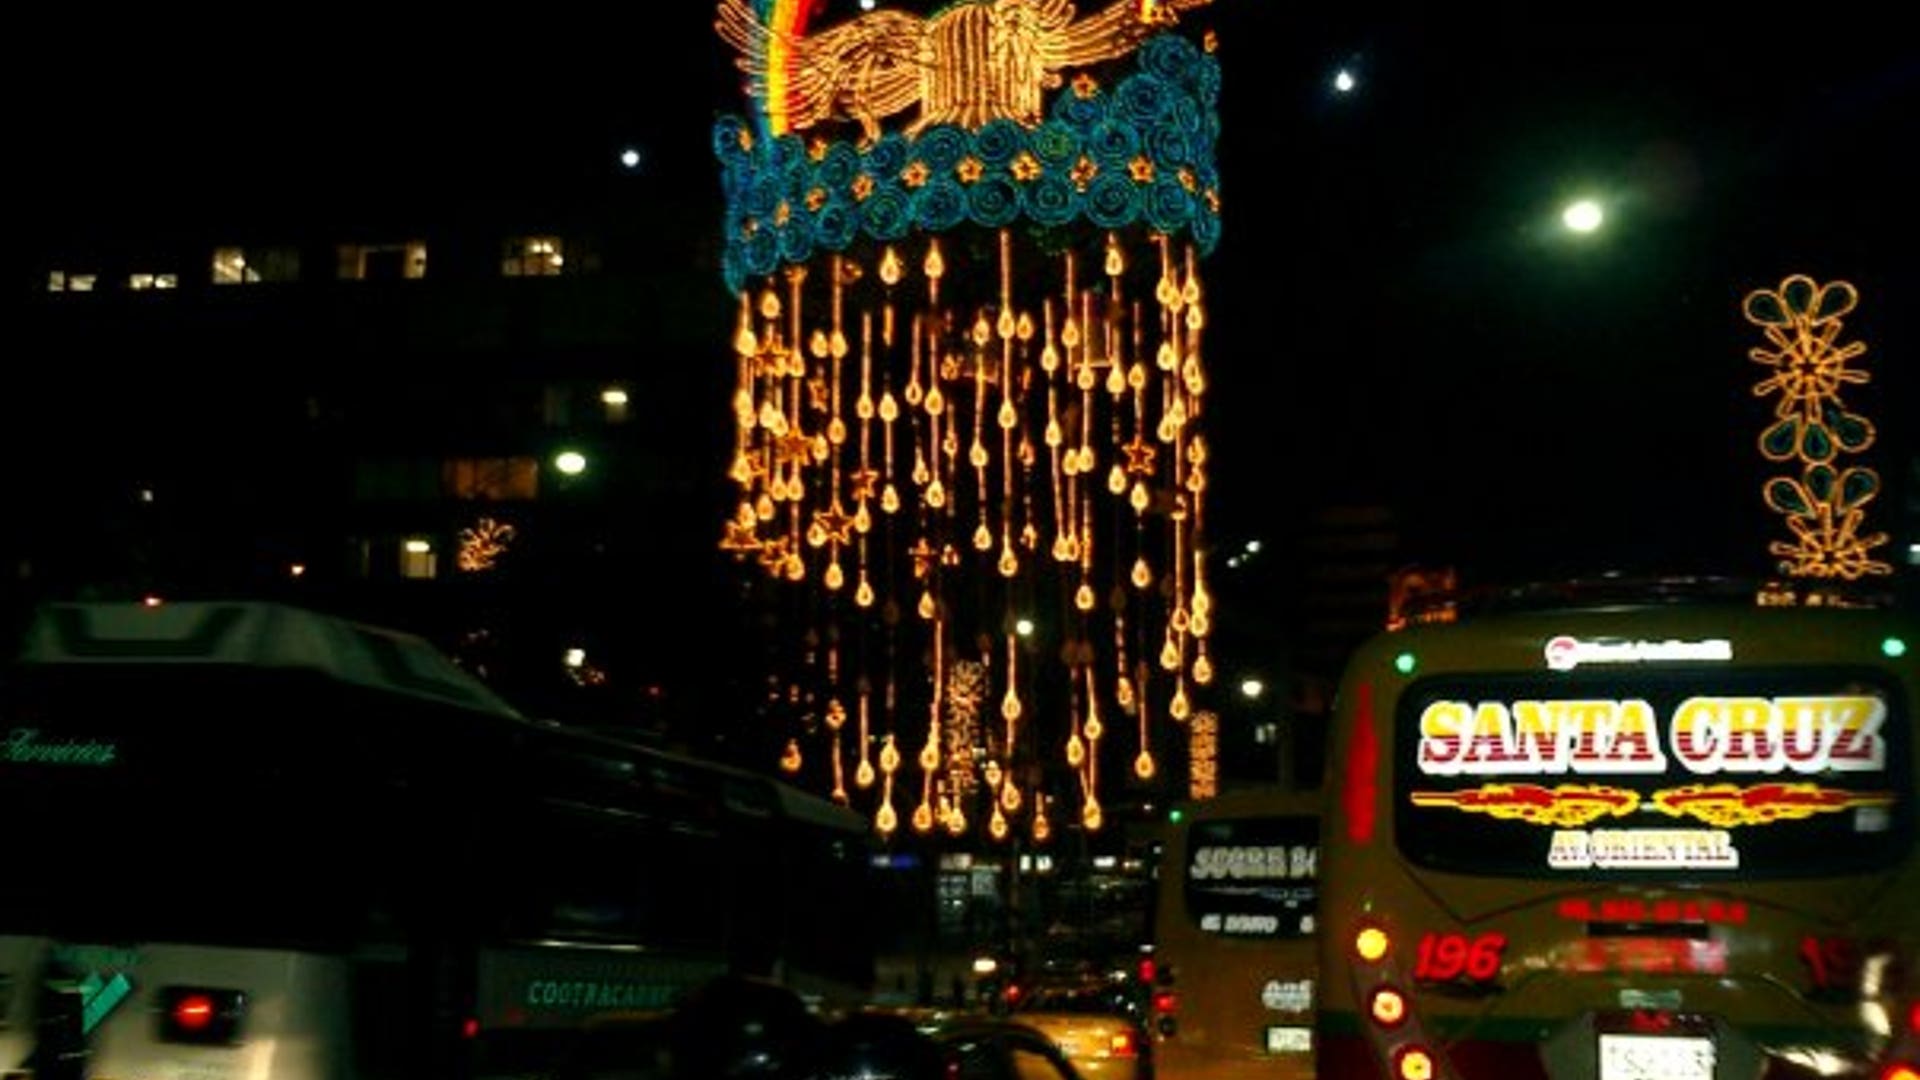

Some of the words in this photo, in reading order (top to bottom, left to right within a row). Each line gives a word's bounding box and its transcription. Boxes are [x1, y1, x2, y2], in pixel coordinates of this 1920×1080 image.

[1419, 700, 1666, 772] SANTA
[1672, 697, 1886, 771] CRUZ
[1414, 933, 1506, 979] 196
